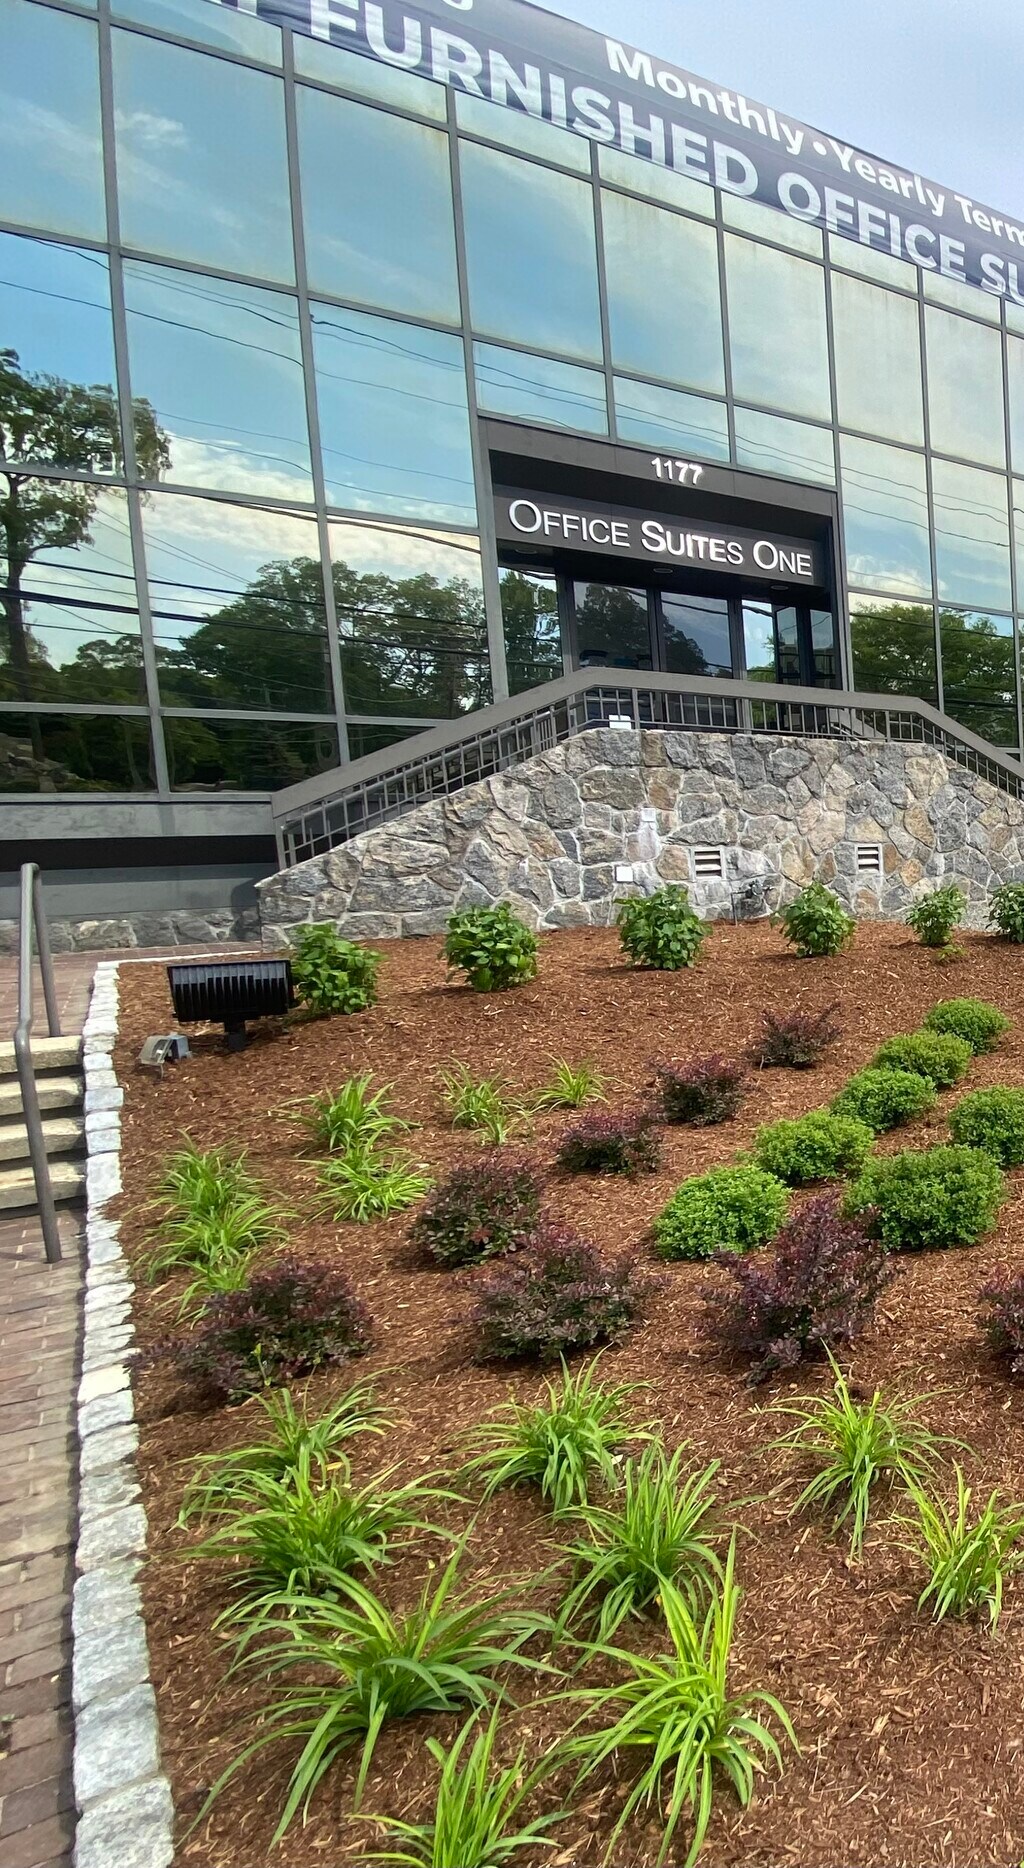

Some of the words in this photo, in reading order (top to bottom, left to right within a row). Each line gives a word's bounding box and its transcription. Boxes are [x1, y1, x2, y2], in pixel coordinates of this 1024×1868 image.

[310, 0, 759, 196] FURNISHED
[776, 171, 965, 283] OFFICE
[605, 39, 804, 155] Monthly
[828, 138, 945, 216] Yearly
[651, 457, 703, 485] 1177
